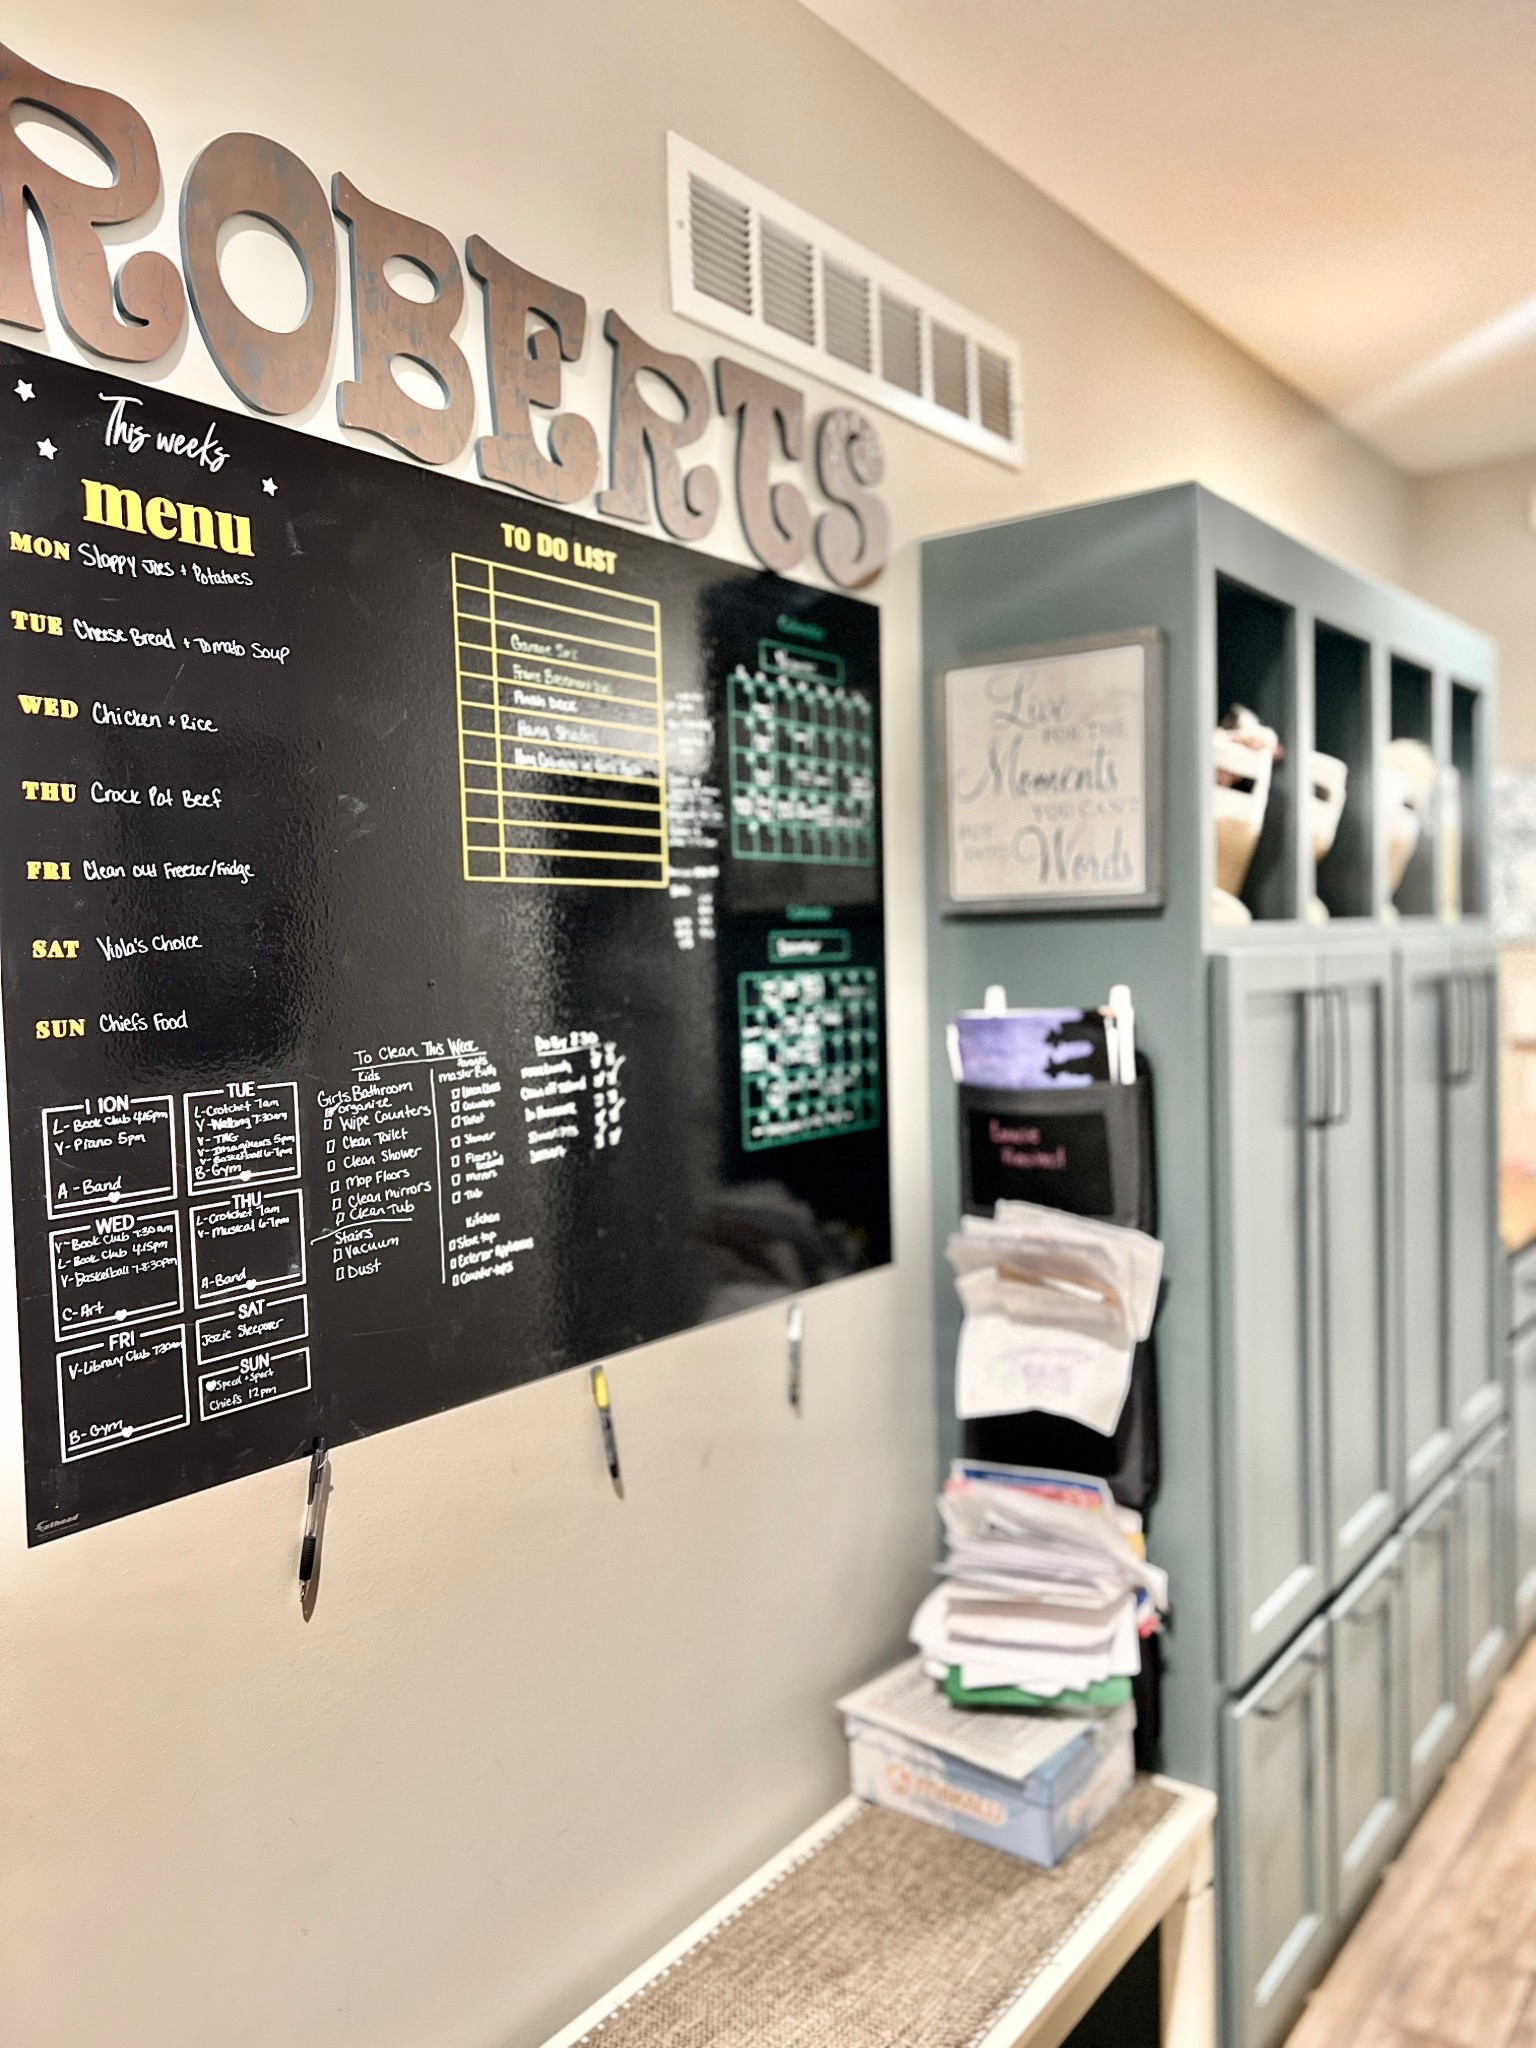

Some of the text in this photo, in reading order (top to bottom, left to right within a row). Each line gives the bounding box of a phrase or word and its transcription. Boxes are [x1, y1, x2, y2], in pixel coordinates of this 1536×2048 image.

[0, 42, 892, 592] ROBERTS
[99, 392, 230, 472] This weeks
[81, 478, 255, 557] menu
[9, 531, 70, 561] MON
[501, 523, 617, 575] TO DO LIST
[78, 542, 137, 577] Sloppy
[192, 563, 253, 586] Potatoes
[10, 610, 63, 636] TUE
[73, 618, 128, 643] Cheese
[130, 627, 176, 650] Bread
[193, 637, 246, 656] Tomato
[252, 643, 290, 664] Soup
[18, 694, 79, 719] WED
[92, 702, 162, 728] Chicken
[181, 713, 218, 732] Rice
[21, 781, 77, 802] THU
[90, 782, 222, 808] Crock Pot Beef
[26, 861, 72, 880] FRI
[82, 861, 126, 881] Clean
[132, 863, 157, 877] out
[32, 940, 80, 959] SAT
[152, 934, 203, 951] Choice
[35, 1018, 86, 1040] SUN
[153, 1010, 188, 1031] Food
[353, 1050, 372, 1065] To
[379, 1046, 418, 1060] Clean
[421, 1041, 444, 1056] This
[358, 1069, 381, 1082] Kids
[226, 1081, 256, 1098] TUE
[317, 1082, 413, 1107] Girls Bathroom
[73, 1117, 103, 1132] Book
[104, 1114, 132, 1126] Club
[375, 1105, 432, 1124] Counters
[74, 1138, 113, 1151] Piano
[118, 1131, 147, 1146] 5pm
[342, 1127, 408, 1150] Clean Toilet
[343, 1147, 422, 1169] Clean Shower
[375, 1168, 411, 1184] Floors
[231, 1190, 262, 1210] THU
[347, 1193, 381, 1208] Clean
[349, 1199, 415, 1221] Clean Tub
[95, 1214, 135, 1235] WED
[71, 1236, 101, 1251] Book
[103, 1231, 130, 1244] Club
[334, 1228, 374, 1245] Stairs
[73, 1255, 100, 1267] Book
[101, 1248, 128, 1260] Club
[344, 1236, 400, 1259] Vacuum
[347, 1257, 382, 1279] Dust
[238, 1299, 265, 1320] SAT
[109, 1330, 135, 1351] FRI
[125, 1349, 150, 1362] Club
[240, 1352, 270, 1375] SUN
[209, 1394, 242, 1411] Chiefs
